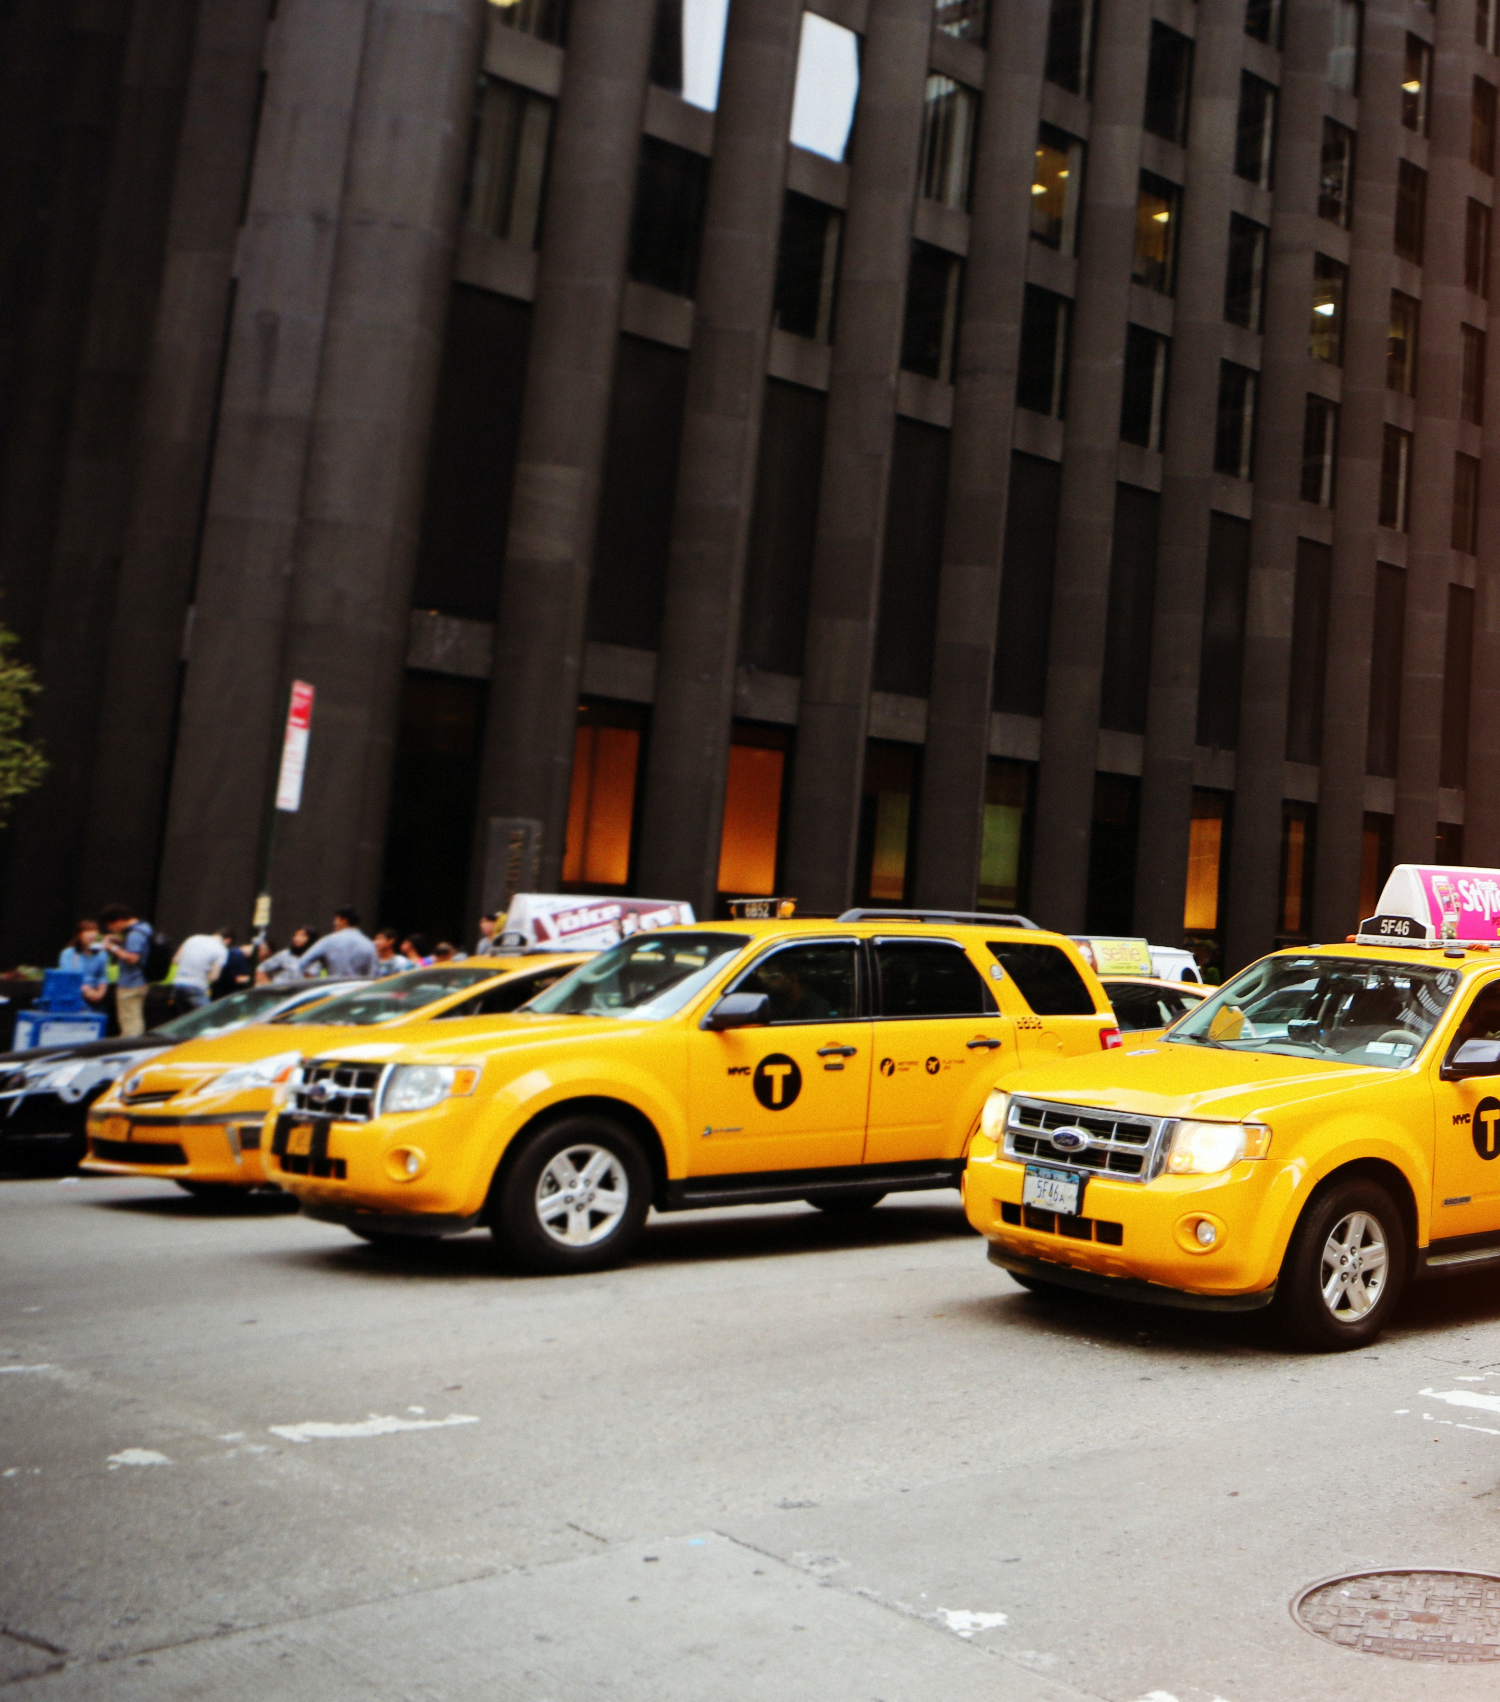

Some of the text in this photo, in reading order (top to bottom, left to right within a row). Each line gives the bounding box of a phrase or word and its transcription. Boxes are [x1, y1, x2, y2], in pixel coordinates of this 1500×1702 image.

[1380, 919, 1410, 936] 5F46
[728, 1066, 751, 1076] NYC
[763, 1064, 791, 1104] T
[1452, 1113, 1471, 1125] NYC
[1480, 1109, 1500, 1152] T
